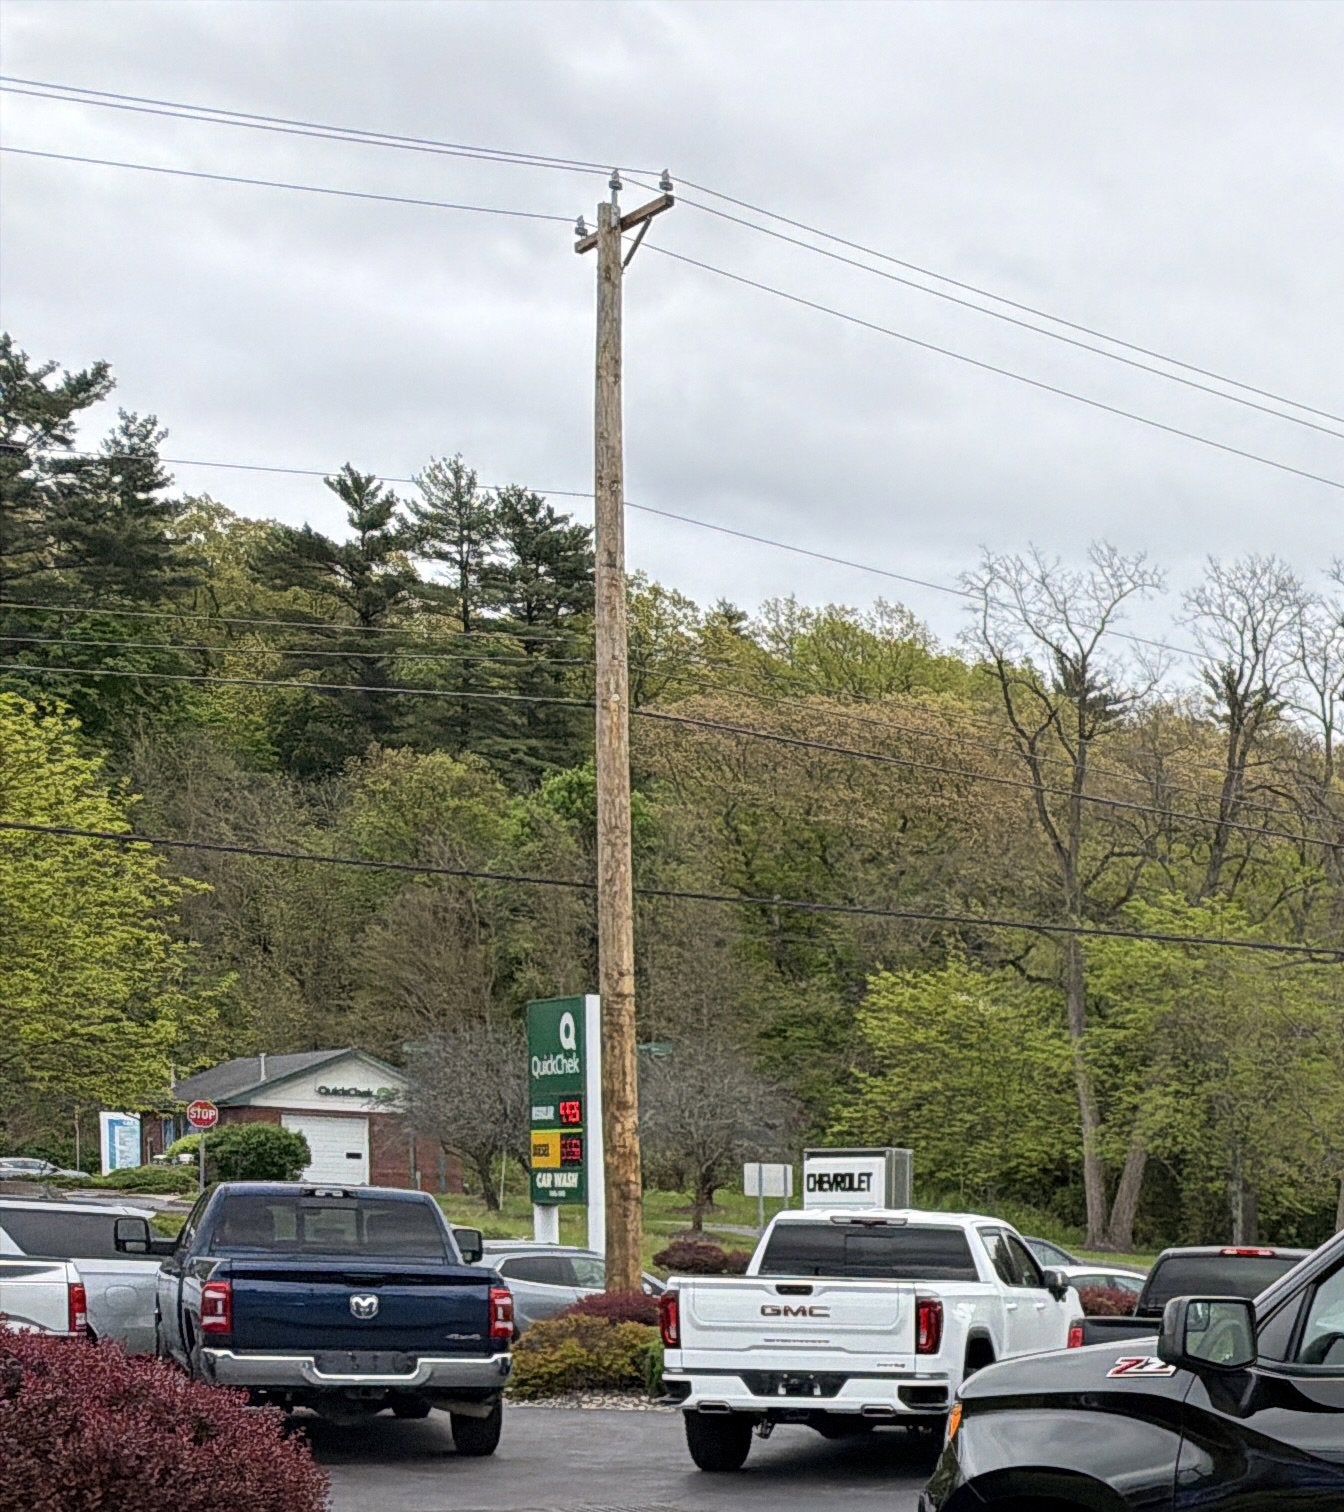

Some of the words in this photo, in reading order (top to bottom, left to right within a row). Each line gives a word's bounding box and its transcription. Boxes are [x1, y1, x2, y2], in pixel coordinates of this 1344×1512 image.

[560, 1011, 576, 1050] Q
[531, 1052, 580, 1079] QuickChek
[190, 1106, 216, 1120] STOP
[536, 1172, 552, 1188] CAR
[553, 1171, 579, 1188] WASH
[806, 1172, 873, 1192] CHEVROLET
[760, 1304, 831, 1318] GMC
